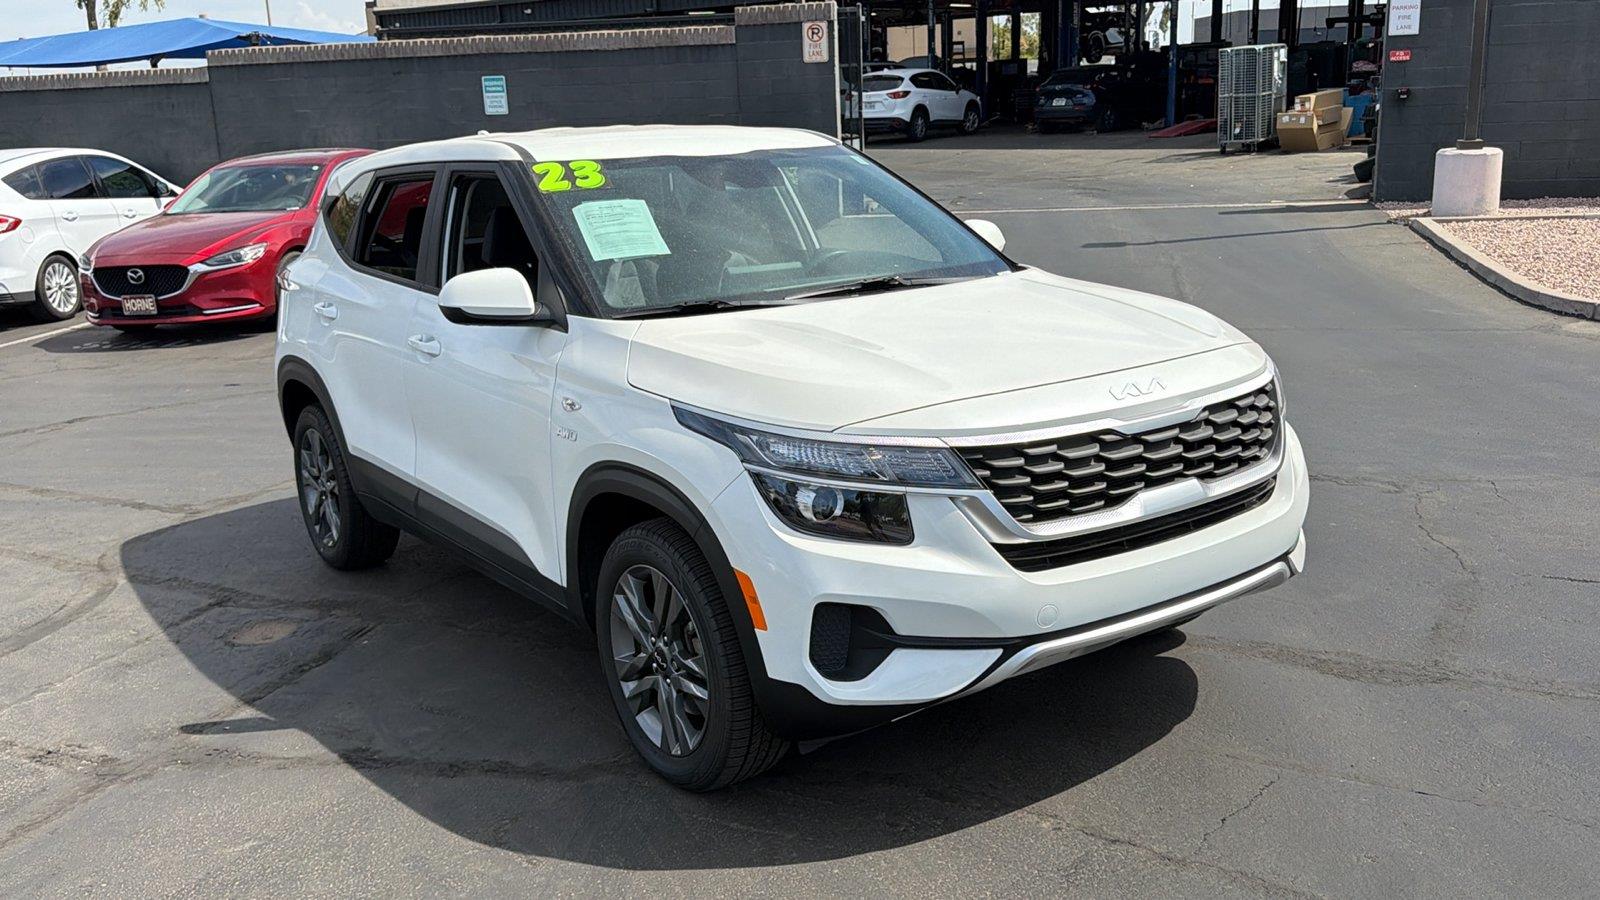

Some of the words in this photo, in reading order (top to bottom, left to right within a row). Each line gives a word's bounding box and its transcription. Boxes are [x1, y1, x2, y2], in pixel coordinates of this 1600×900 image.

[532, 160, 606, 192] 23
[124, 298, 156, 311] HORNE
[557, 425, 579, 442] AWD
